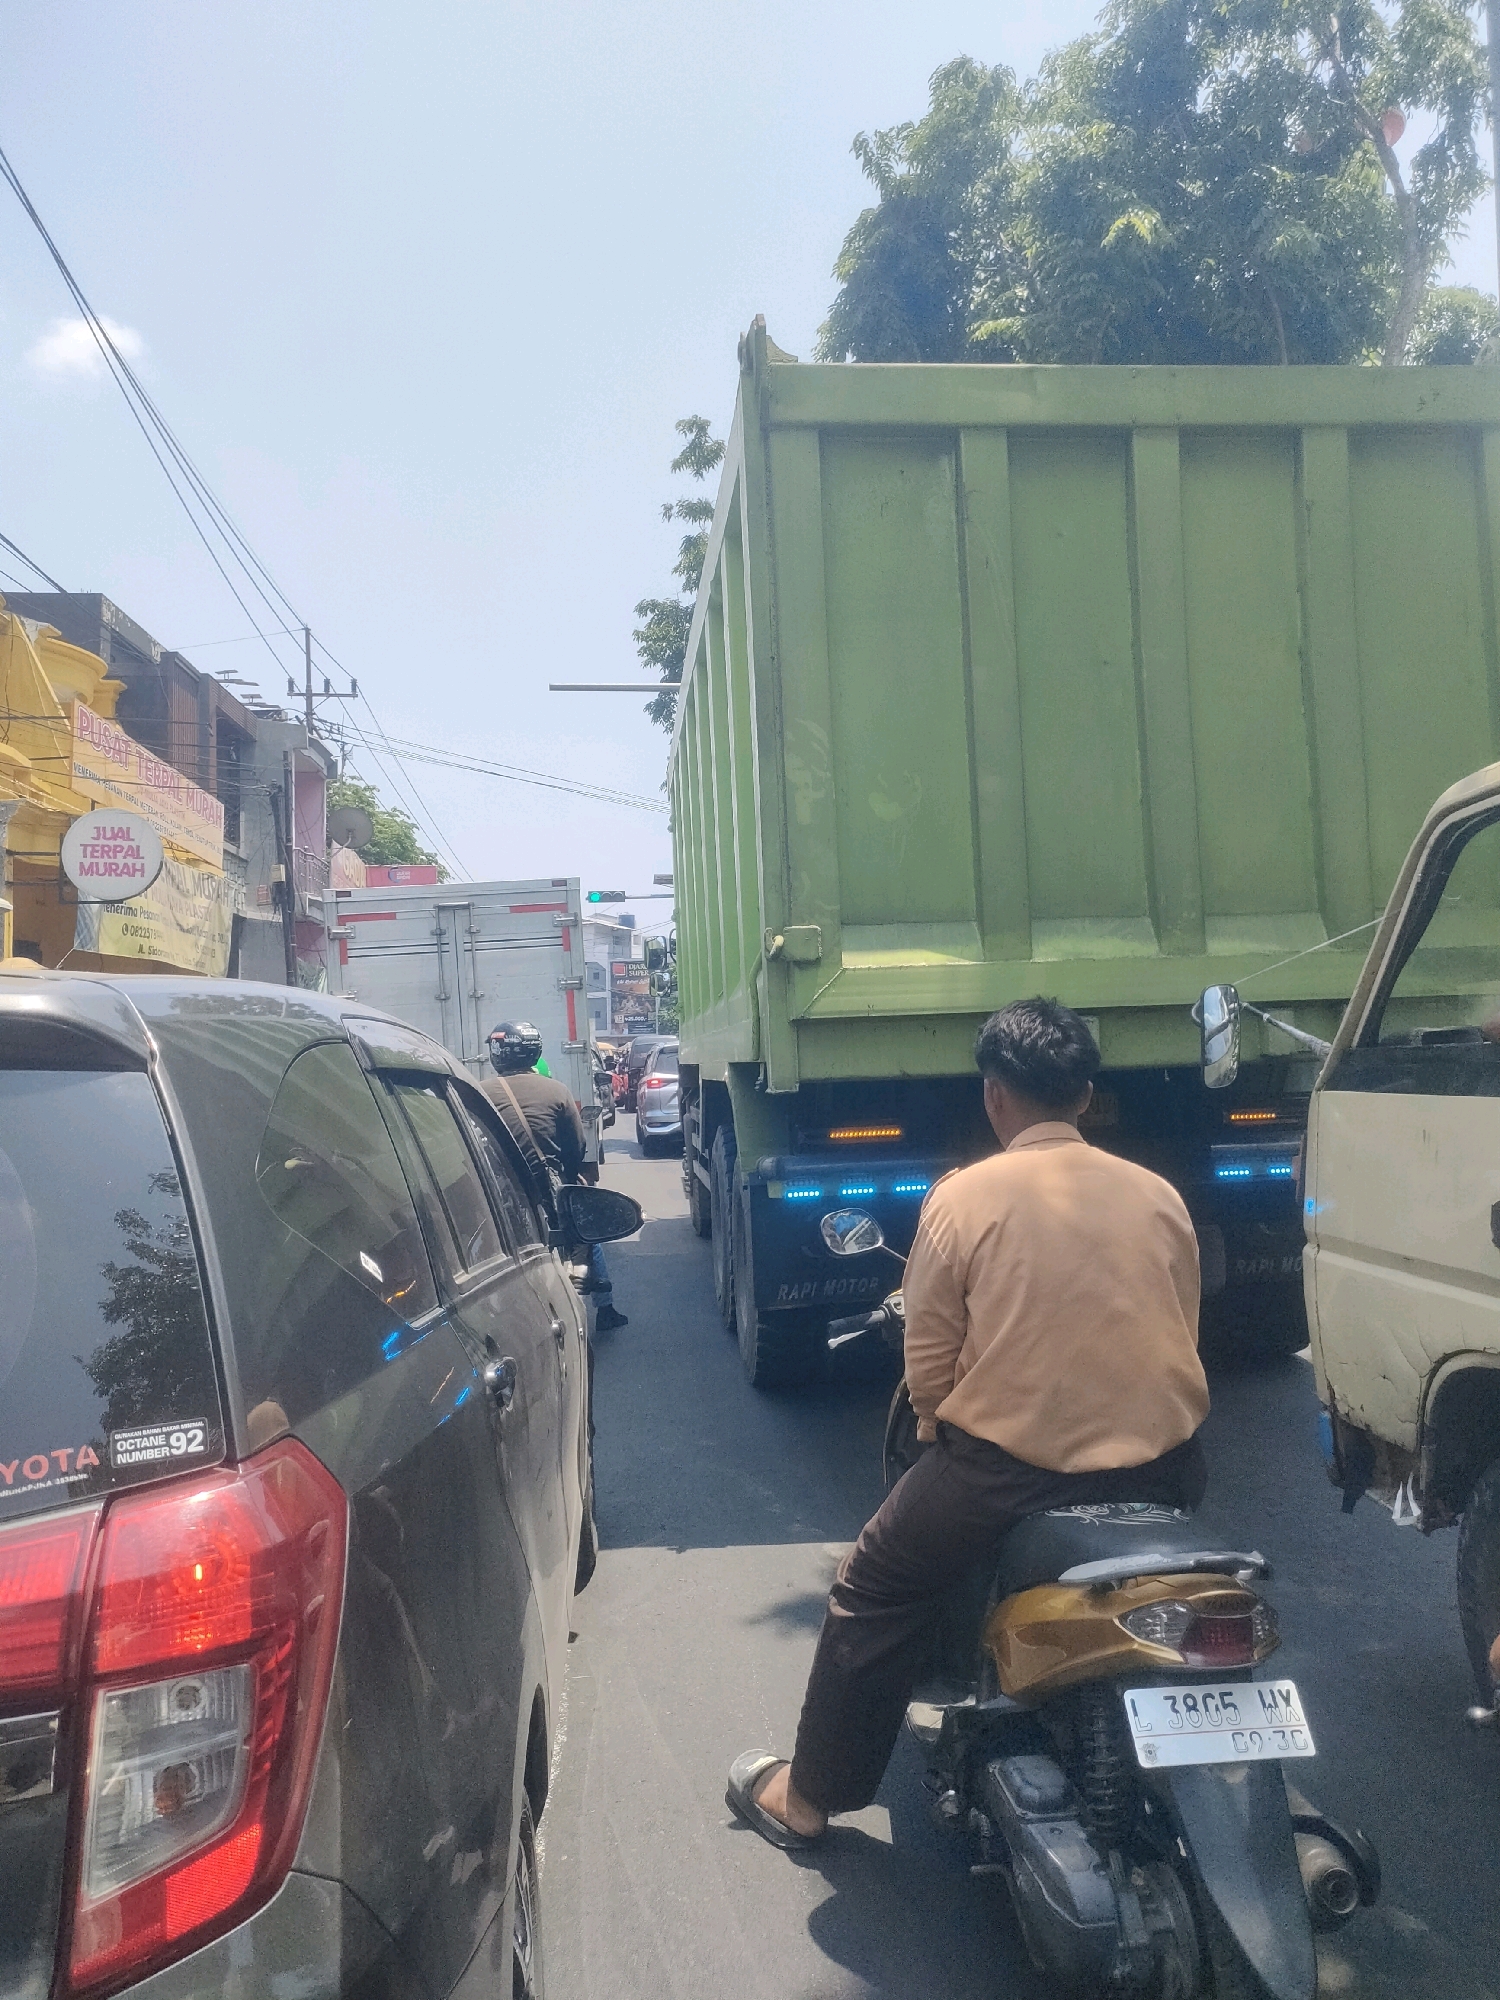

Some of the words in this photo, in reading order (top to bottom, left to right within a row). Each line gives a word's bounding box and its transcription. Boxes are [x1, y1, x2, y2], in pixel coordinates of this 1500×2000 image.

[78, 705, 132, 771] PUSAT
[135, 746, 183, 805] TERPAL
[186, 783, 222, 831] MURAH
[90, 826, 135, 842] JUAL
[80, 844, 145, 860] TERPAL
[78, 861, 145, 878] MURAH
[777, 1281, 817, 1300] RAPI
[823, 1276, 879, 1296] MOTOR
[116, 1434, 166, 1451] OCTANE
[117, 1446, 171, 1464] NUMBER
[170, 1429, 204, 1456] 92
[1129, 1698, 1152, 1733] L
[1162, 1691, 1242, 1729] 3805
[1257, 1687, 1301, 1724] WX
